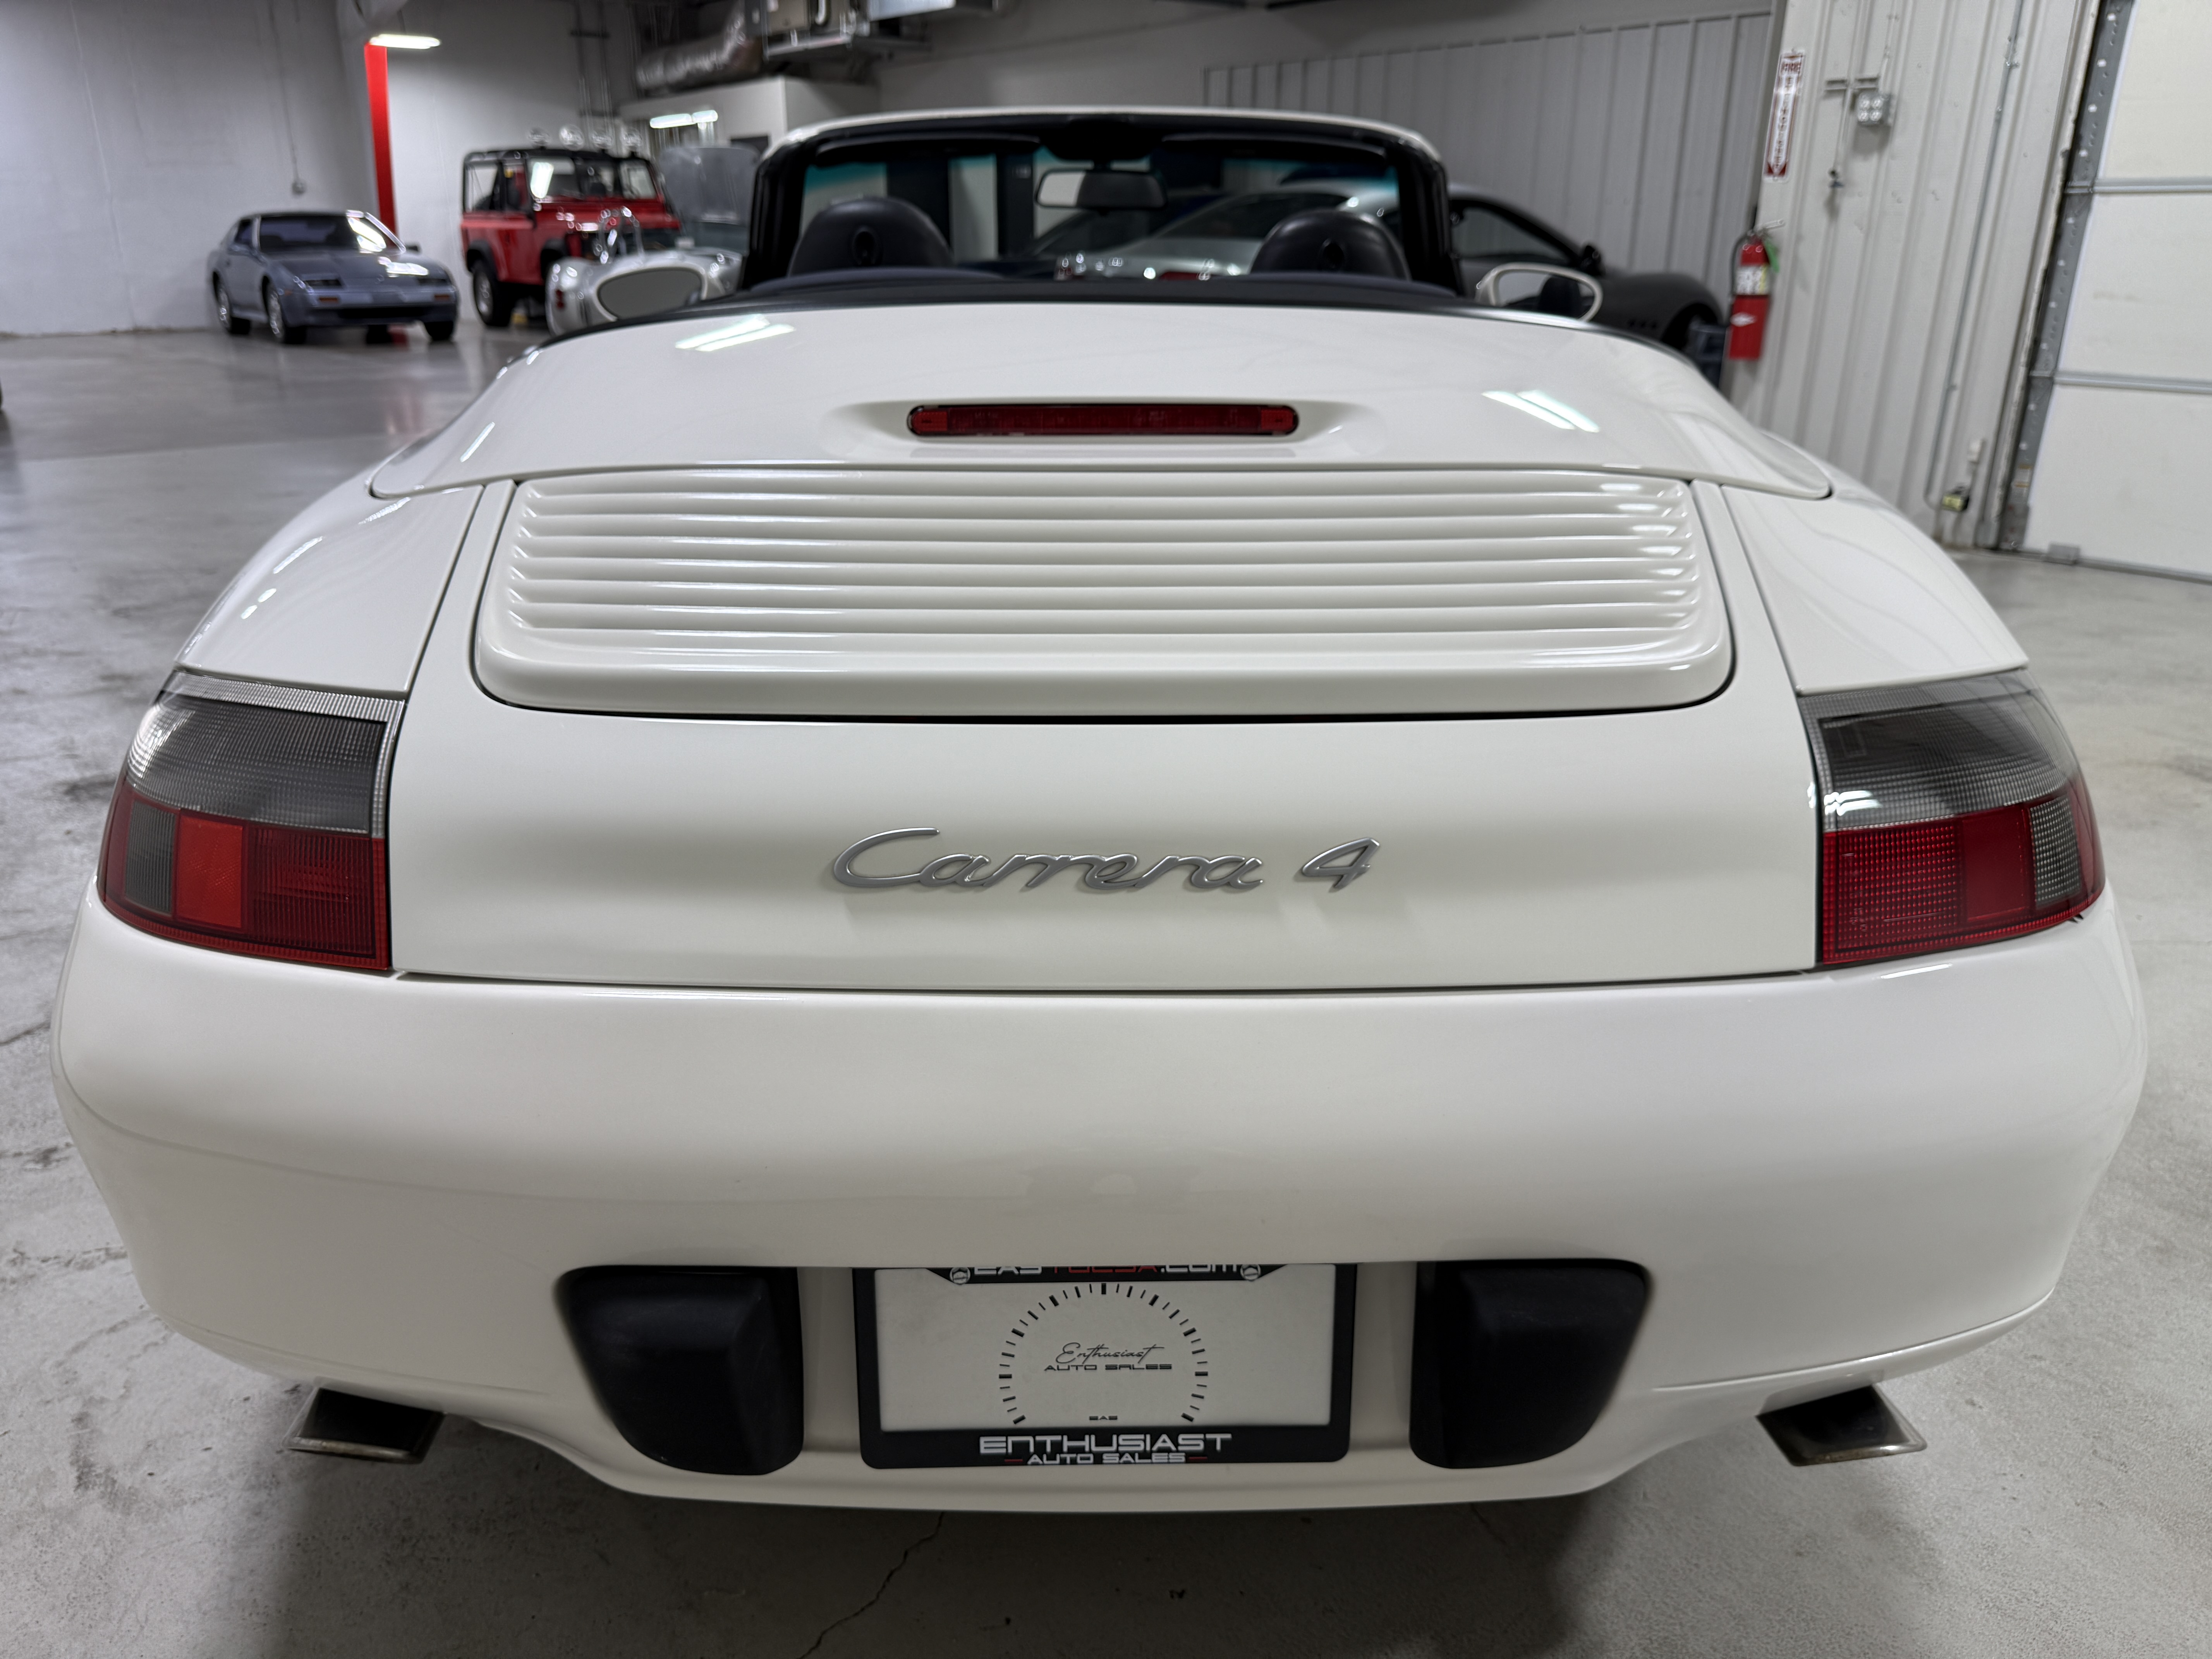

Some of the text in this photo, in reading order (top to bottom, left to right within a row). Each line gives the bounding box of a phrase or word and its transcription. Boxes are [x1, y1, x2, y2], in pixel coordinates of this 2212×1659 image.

[833, 827, 1380, 890] Carrera 4
[1055, 1342, 1165, 1365] Enthusiast
[979, 1433, 1232, 1454] ENTHUSIAST
[1027, 1452, 1186, 1465] AUTO SALES
